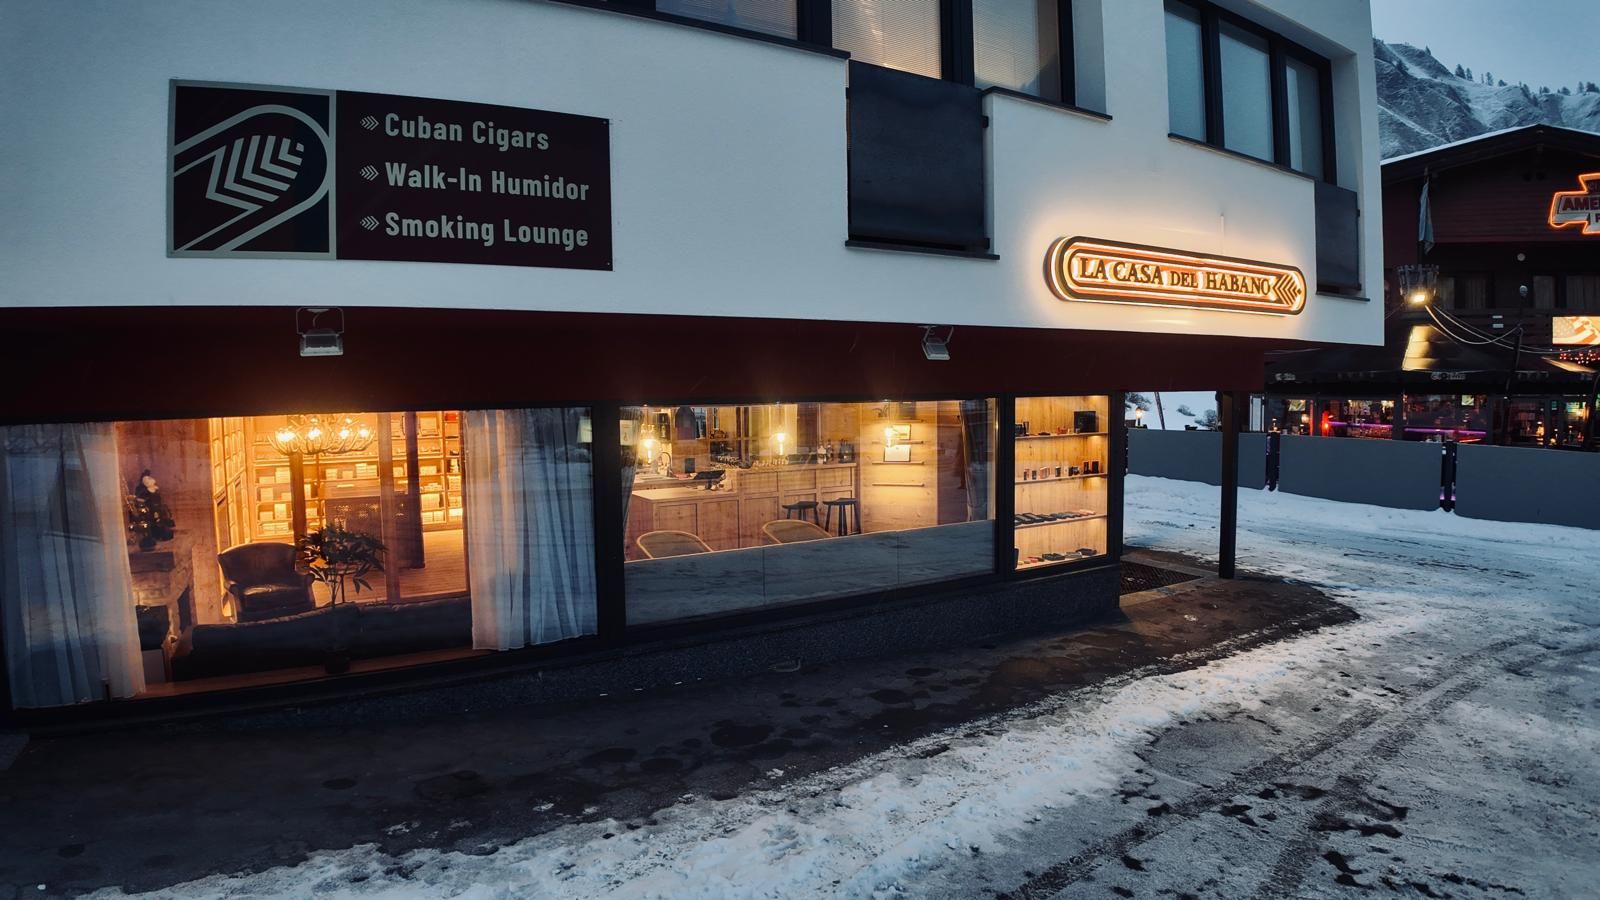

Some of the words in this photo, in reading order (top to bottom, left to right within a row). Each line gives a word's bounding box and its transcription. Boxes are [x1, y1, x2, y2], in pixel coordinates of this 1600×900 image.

[385, 113, 463, 142] Cuban
[472, 120, 549, 151] Cigars
[385, 162, 482, 192] Walk-In
[492, 170, 589, 200] Humidor
[385, 212, 495, 247] Smoking
[504, 219, 589, 251] Lounge
[1079, 257, 1107, 280] LA
[1113, 261, 1164, 285] CASA
[1170, 270, 1199, 288] DEL
[1206, 271, 1271, 296] HABANO
